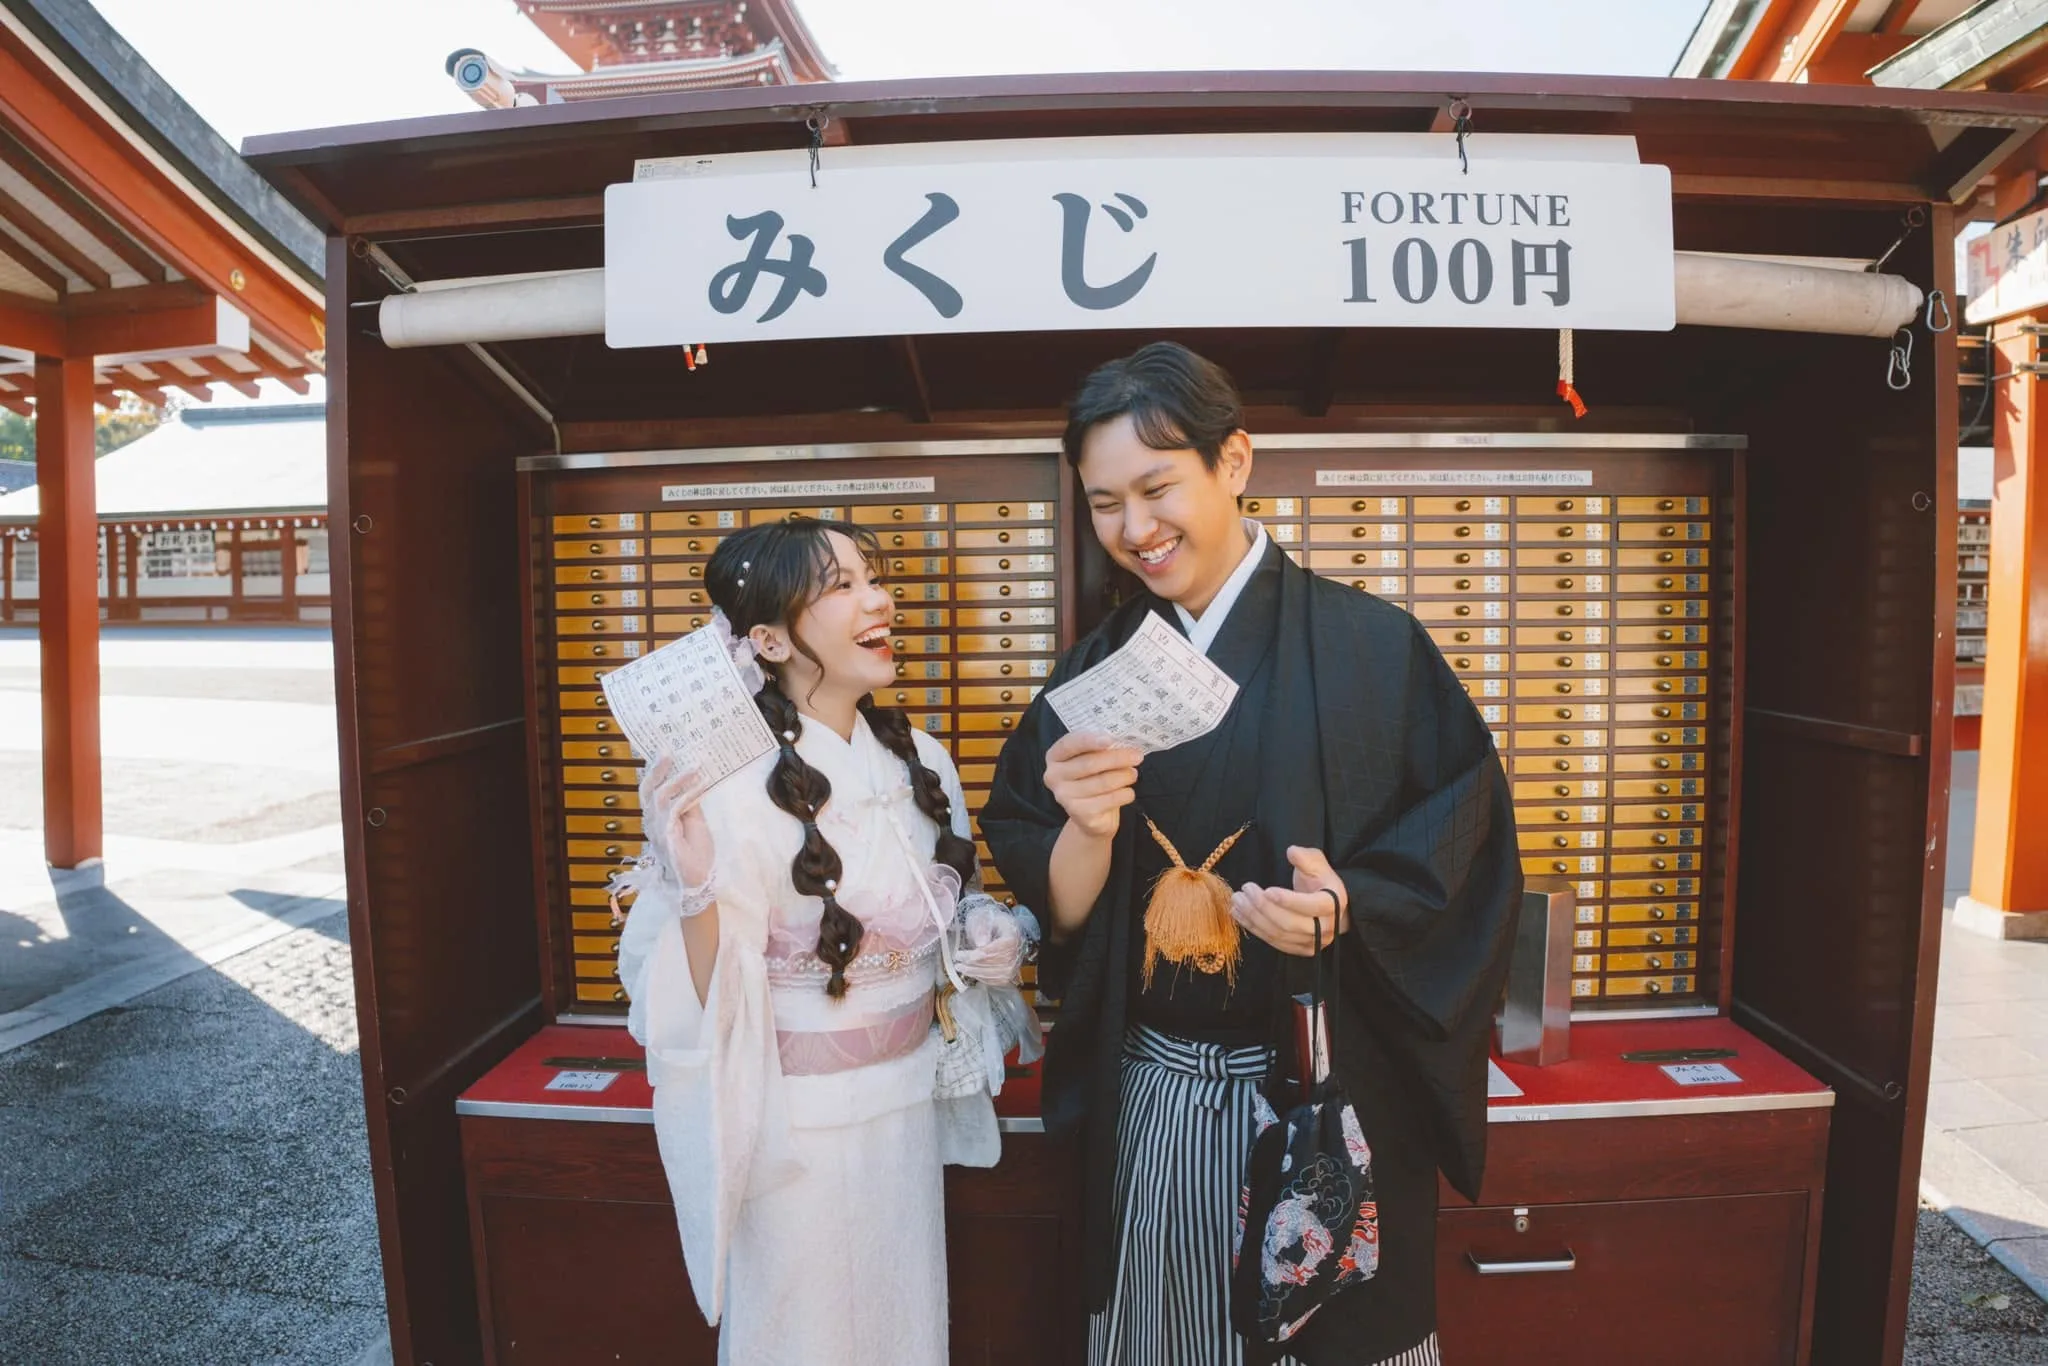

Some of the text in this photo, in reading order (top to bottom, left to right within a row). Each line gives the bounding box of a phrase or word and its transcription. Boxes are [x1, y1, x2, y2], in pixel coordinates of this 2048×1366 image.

[1341, 191, 1571, 227] FORTUNE
[707, 191, 1158, 324] みくじ
[1342, 236, 1572, 308] 100円
